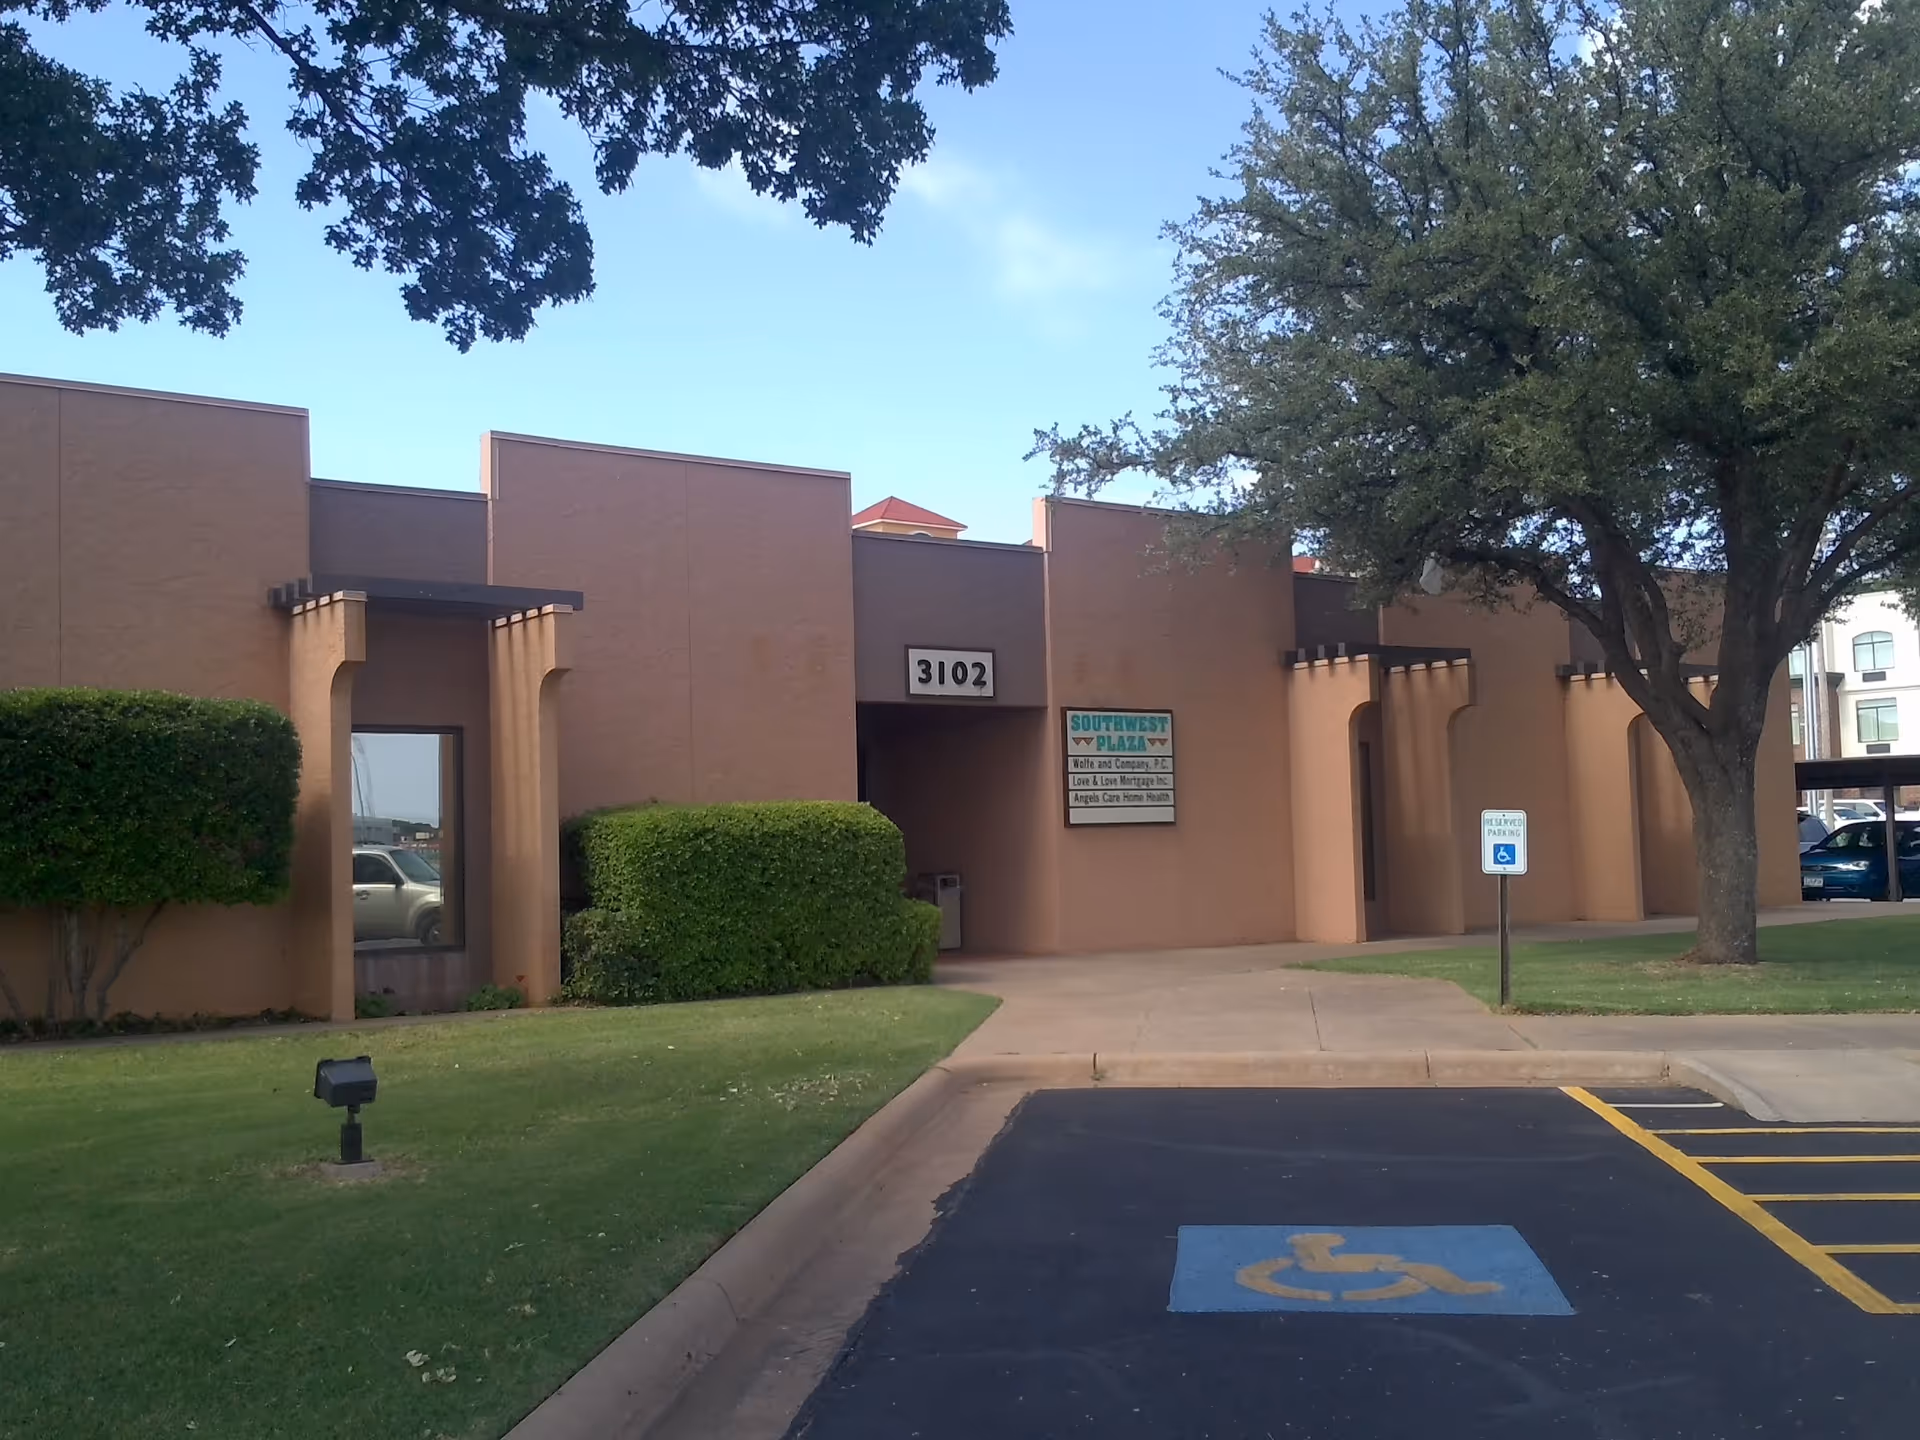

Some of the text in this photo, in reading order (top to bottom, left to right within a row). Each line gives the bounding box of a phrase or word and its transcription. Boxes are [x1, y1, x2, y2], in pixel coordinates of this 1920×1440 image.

[917, 659, 987, 687] 3102
[1071, 714, 1169, 733] SOUTHWEST
[1096, 735, 1147, 752] PLAZA
[1073, 758, 1095, 769] Wolfe
[1098, 759, 1112, 769] and
[1073, 775, 1090, 786] Love
[1093, 775, 1098, 786] &
[1101, 775, 1117, 786] Love
[1120, 775, 1154, 788] Mortgage
[1074, 792, 1170, 804] Angels Care Home Health
[1485, 818, 1523, 827] RESERVED
[1488, 829, 1521, 837] PARKING
